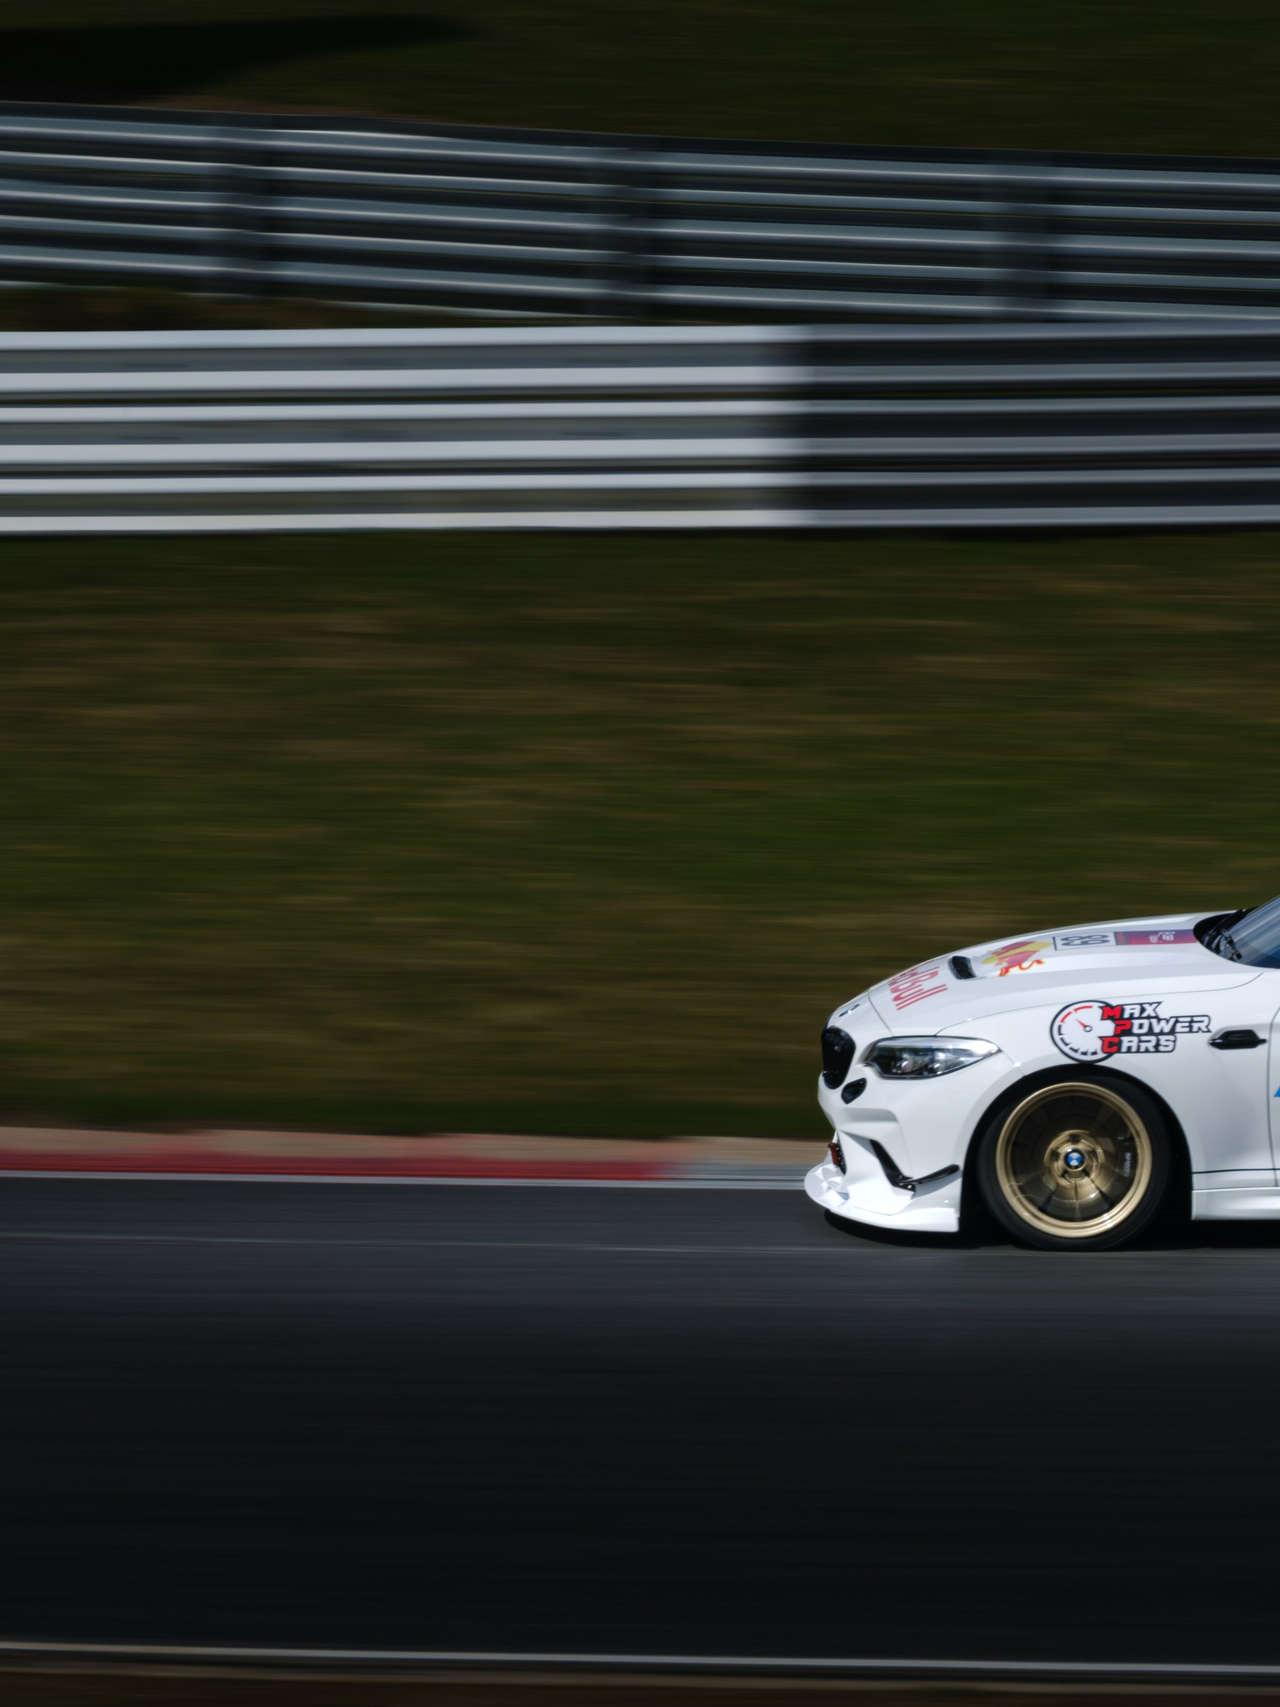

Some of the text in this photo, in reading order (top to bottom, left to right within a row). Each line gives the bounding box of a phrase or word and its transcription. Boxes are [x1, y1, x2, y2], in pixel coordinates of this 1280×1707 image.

[1101, 1002, 1161, 1020] MAX
[1115, 1016, 1210, 1035] POWER
[1102, 1035, 1175, 1053] CARS
